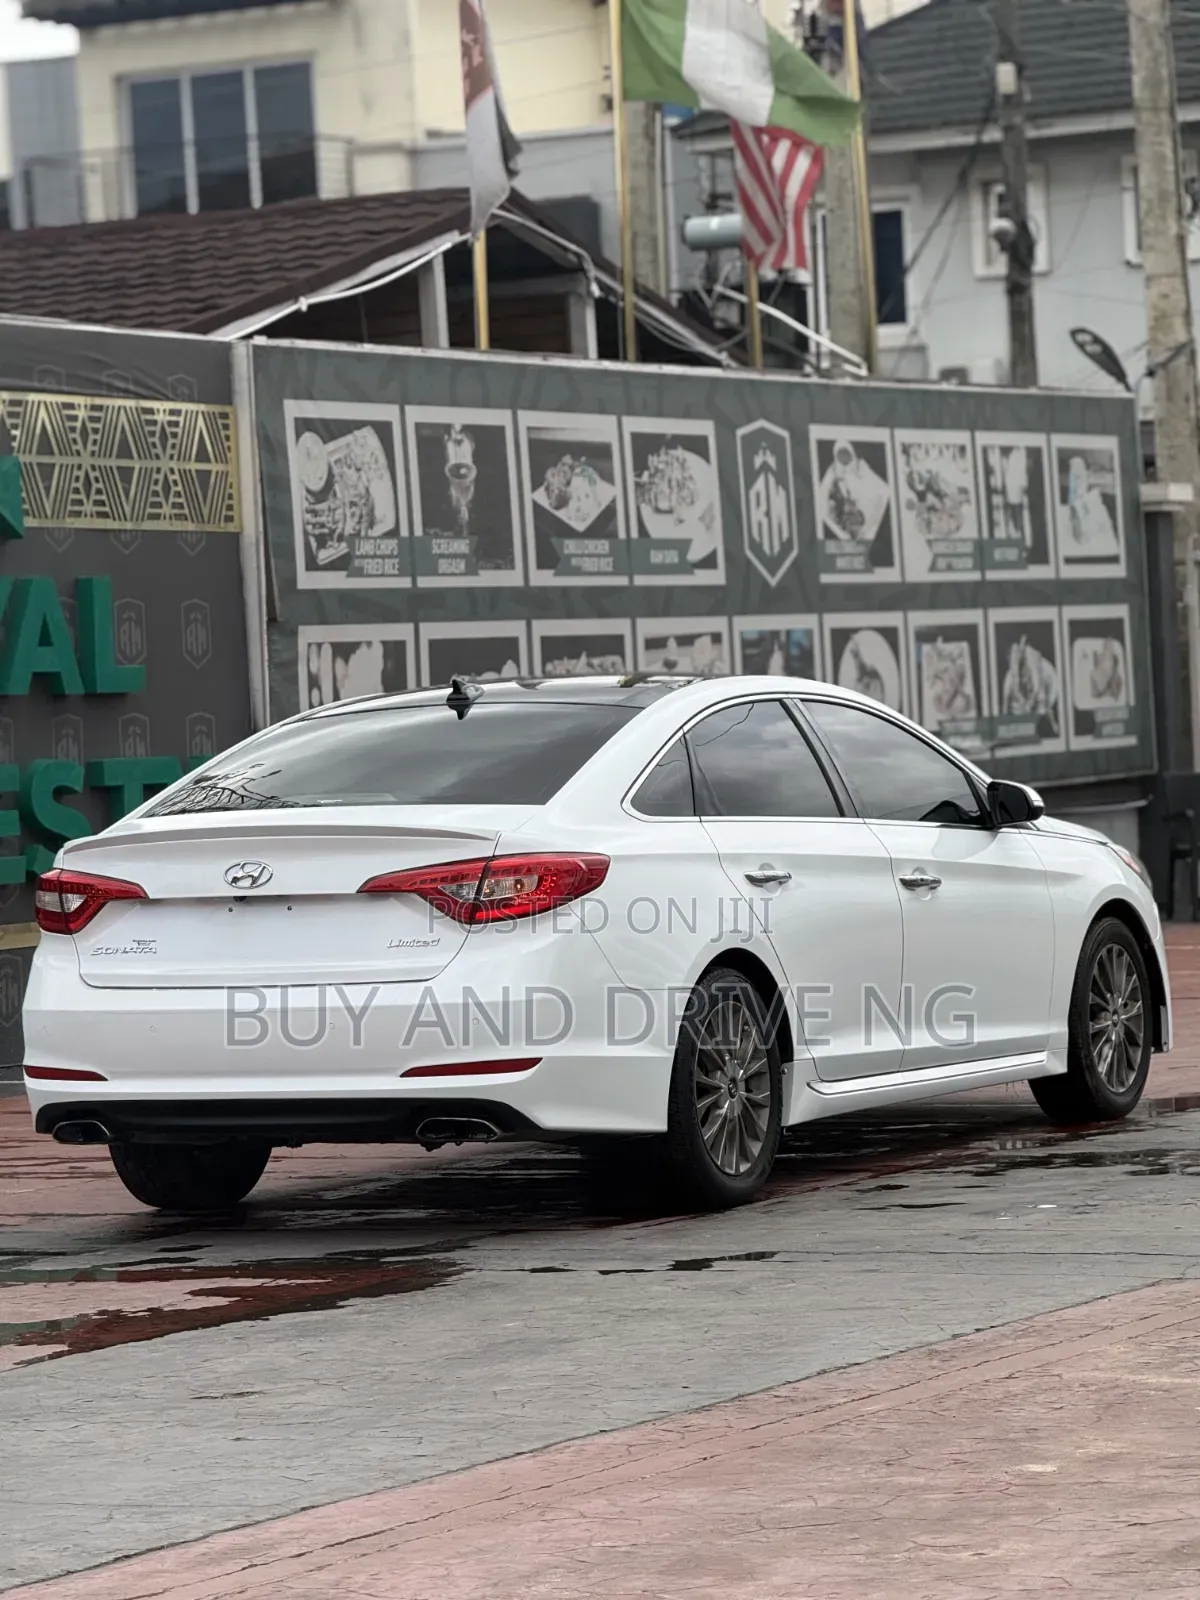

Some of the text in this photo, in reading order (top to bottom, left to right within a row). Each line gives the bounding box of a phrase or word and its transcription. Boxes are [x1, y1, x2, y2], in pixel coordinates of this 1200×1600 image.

[355, 539, 398, 555] LAMB CHOPS
[432, 538, 470, 554] SCREAMING
[364, 558, 384, 575] FRIED
[384, 558, 399, 575] RICE
[387, 937, 441, 948] Limited
[91, 946, 157, 956] SONATA
